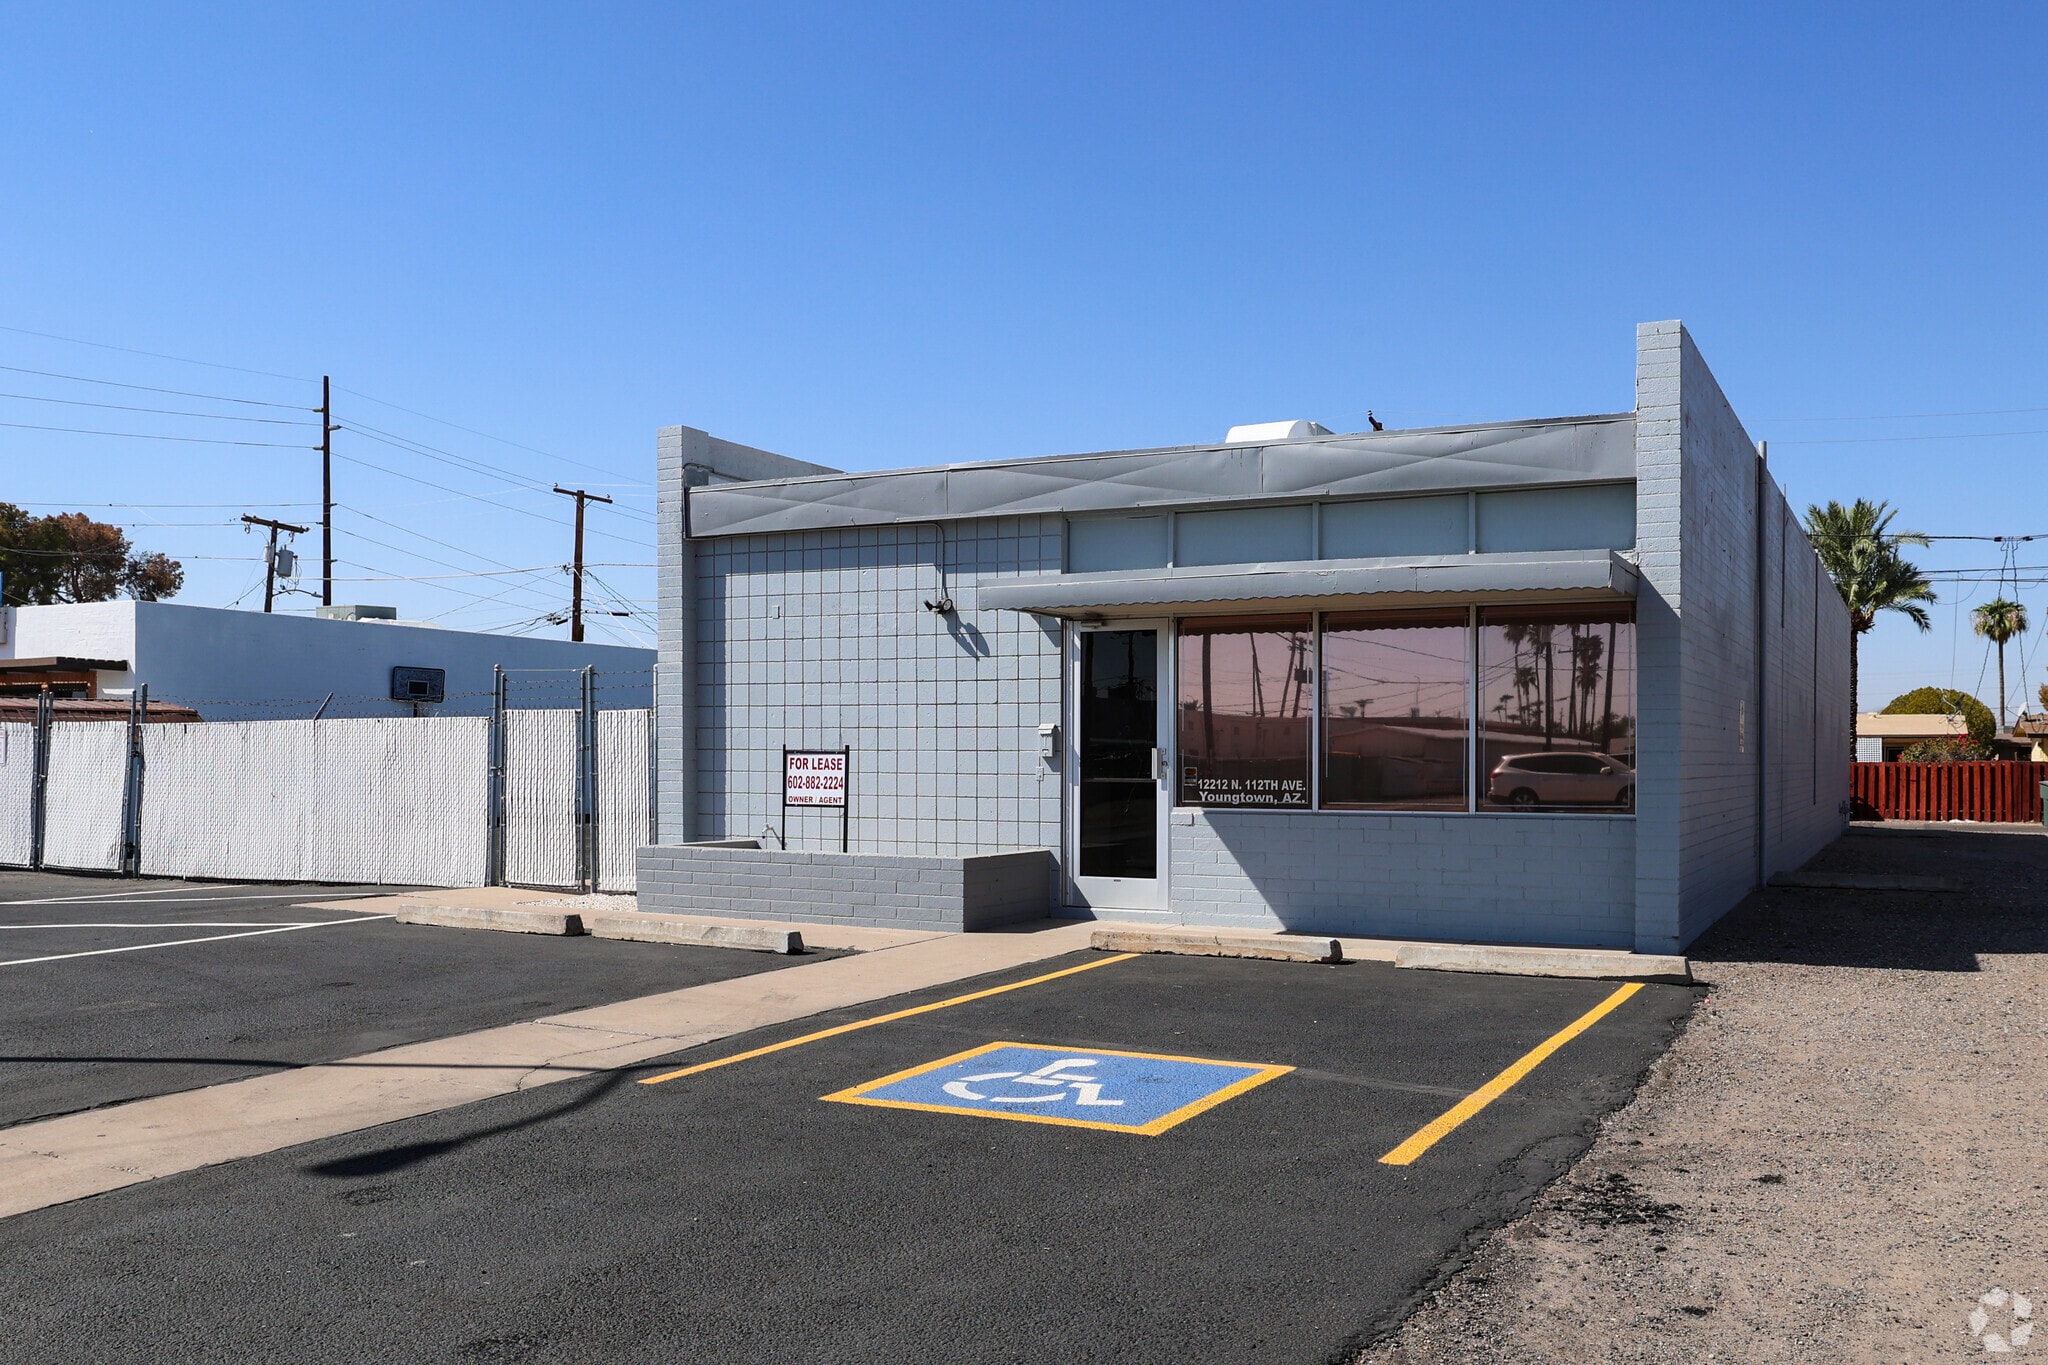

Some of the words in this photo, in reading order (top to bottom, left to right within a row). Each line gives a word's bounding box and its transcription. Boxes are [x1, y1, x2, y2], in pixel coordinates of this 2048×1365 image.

[790, 758, 808, 770] FOR
[812, 758, 842, 770] LEASE
[1198, 779, 1228, 790] 12212
[1232, 780, 1242, 790] N.
[1246, 780, 1278, 790] 112TH
[1282, 780, 1306, 790] AVE.
[1199, 792, 1278, 804] Youngtown,
[1282, 792, 1306, 804] AZ.
